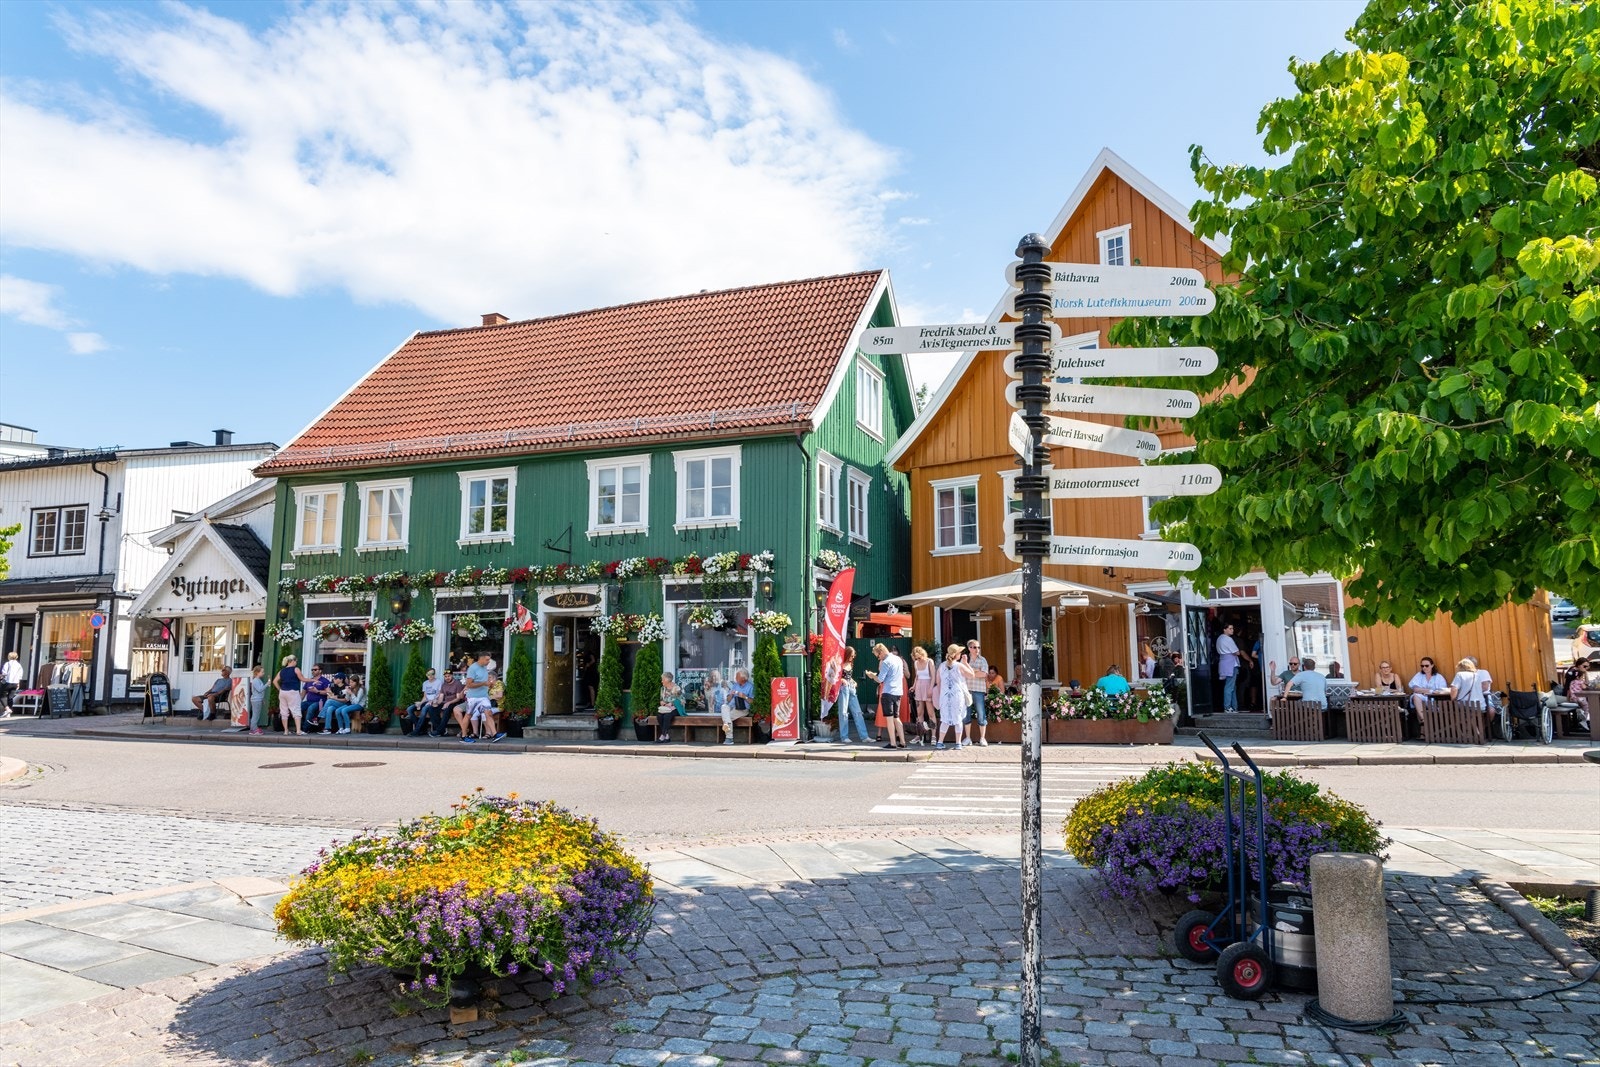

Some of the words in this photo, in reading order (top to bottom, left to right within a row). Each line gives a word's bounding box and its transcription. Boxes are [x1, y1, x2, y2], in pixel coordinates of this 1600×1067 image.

[1055, 272, 1099, 283] Båthavna
[1170, 276, 1197, 286] 200m
[1055, 298, 1084, 309] Norsk
[1087, 297, 1172, 308] Lutefiskmuseum
[1179, 296, 1207, 306] 200m
[920, 328, 955, 338] Fredrik
[957, 325, 987, 336] Stabel
[988, 325, 997, 335] &
[872, 336, 894, 346] 85m
[920, 338, 990, 350] AvisTegnernes
[991, 336, 1011, 347] Hus
[1056, 358, 1105, 369] Julehuset
[1179, 357, 1202, 368] 70m
[1053, 392, 1094, 404] Akvariet
[1166, 398, 1193, 409] 200m
[1049, 425, 1073, 439] alleri
[1073, 430, 1104, 443] Havstad
[1136, 439, 1156, 451] 200m
[1180, 474, 1213, 486] 110m
[1052, 544, 1139, 560] Turistinformasjon
[1168, 550, 1194, 561] 200m
